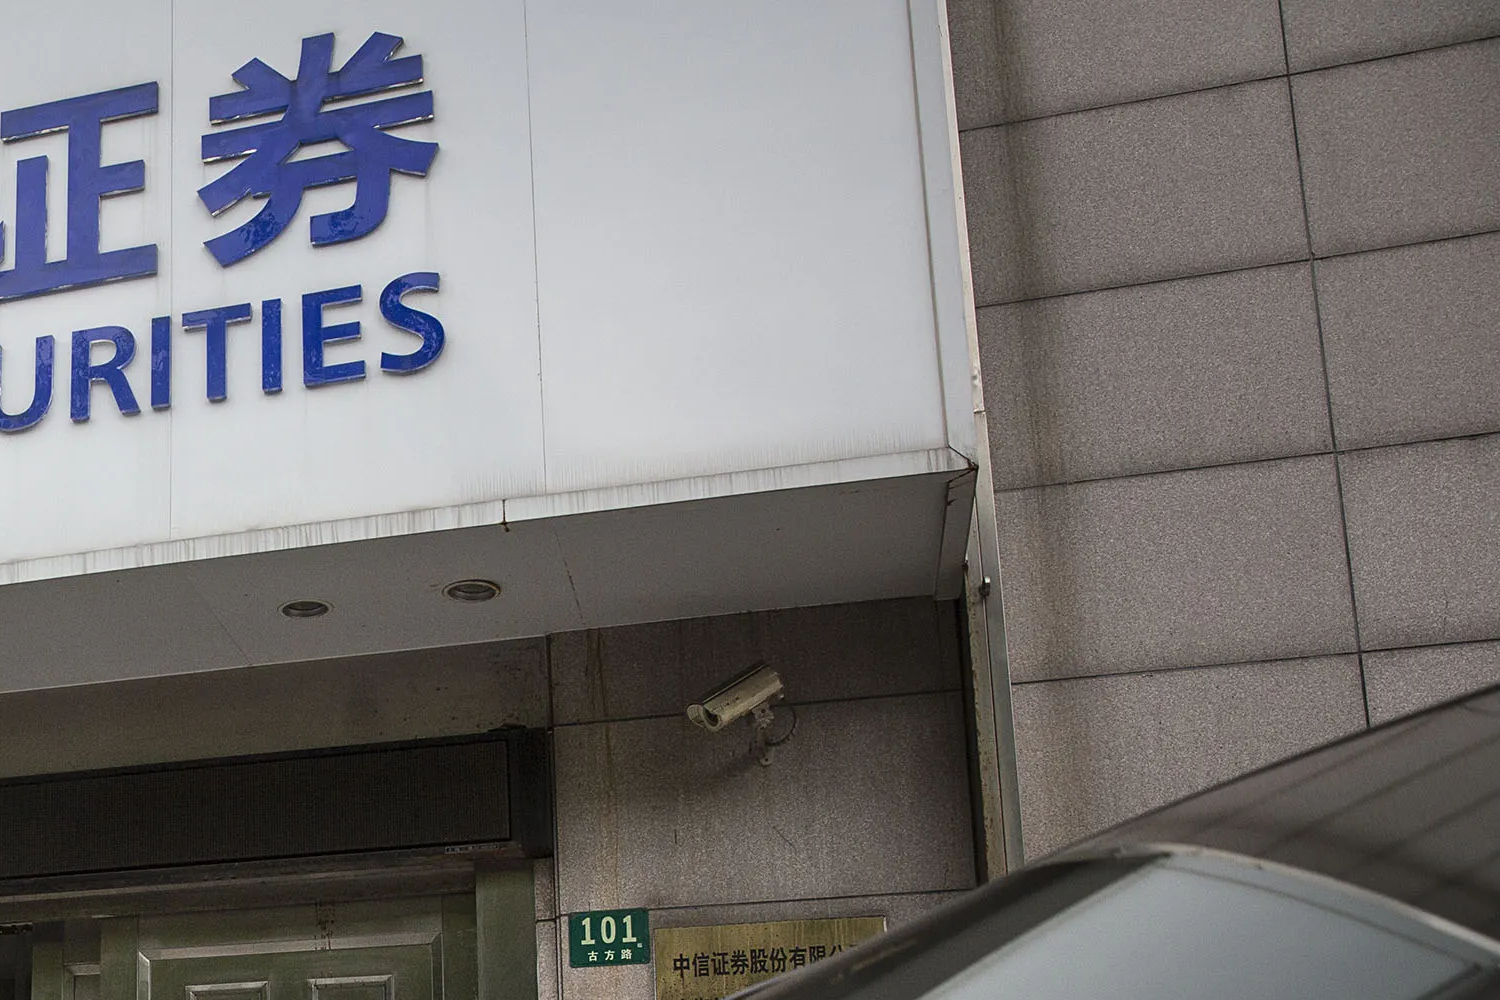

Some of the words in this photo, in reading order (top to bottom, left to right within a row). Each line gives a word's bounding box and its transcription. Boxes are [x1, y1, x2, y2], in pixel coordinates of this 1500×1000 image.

[581, 915, 637, 945] 101
[588, 949, 632, 961] 古方路
[673, 944, 857, 978] 中信证券股份有限
